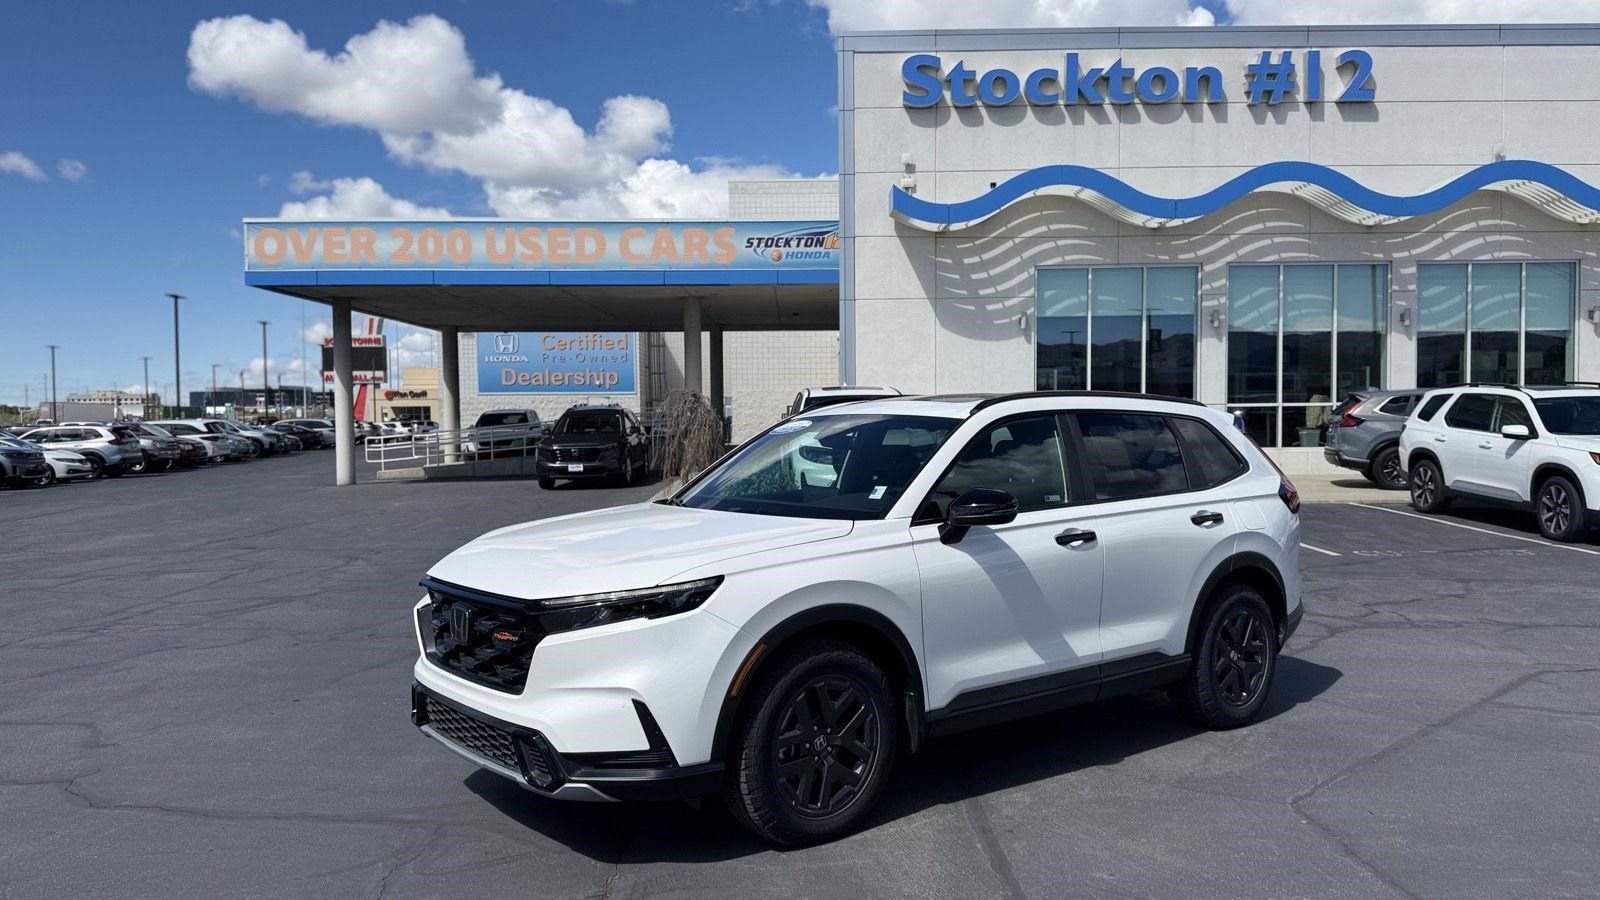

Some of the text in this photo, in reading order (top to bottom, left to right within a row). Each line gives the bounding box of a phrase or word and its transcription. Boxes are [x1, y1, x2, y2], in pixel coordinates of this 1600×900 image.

[902, 50, 1376, 109] Stockton #12
[254, 227, 737, 264] OVER 200 USED CARS
[785, 251, 831, 260] HONDA
[540, 332, 629, 350] Certified
[484, 355, 530, 363] HONDA
[542, 353, 629, 363] Pre-Owned
[502, 368, 620, 389] Dealership
